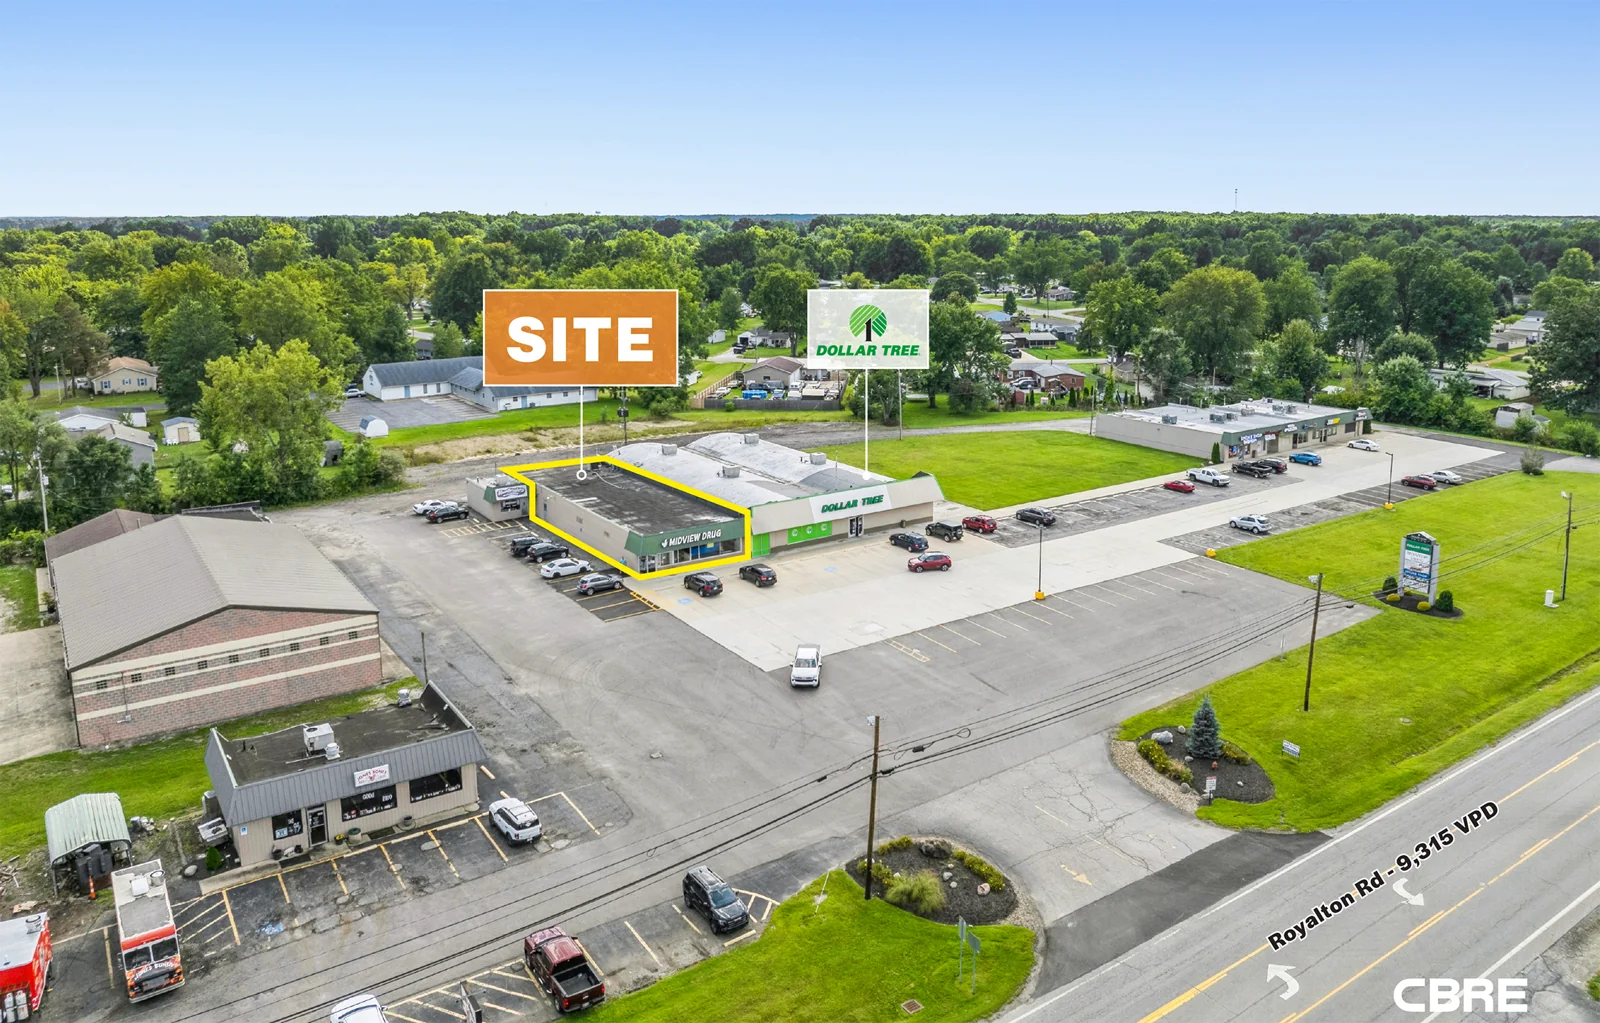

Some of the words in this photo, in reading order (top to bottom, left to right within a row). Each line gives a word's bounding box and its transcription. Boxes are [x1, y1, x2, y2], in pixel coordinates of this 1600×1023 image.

[821, 499, 858, 513] DOLLAR
[861, 494, 884, 506] TREE
[669, 532, 701, 547] MIDVIEW
[701, 529, 722, 541] DRUG
